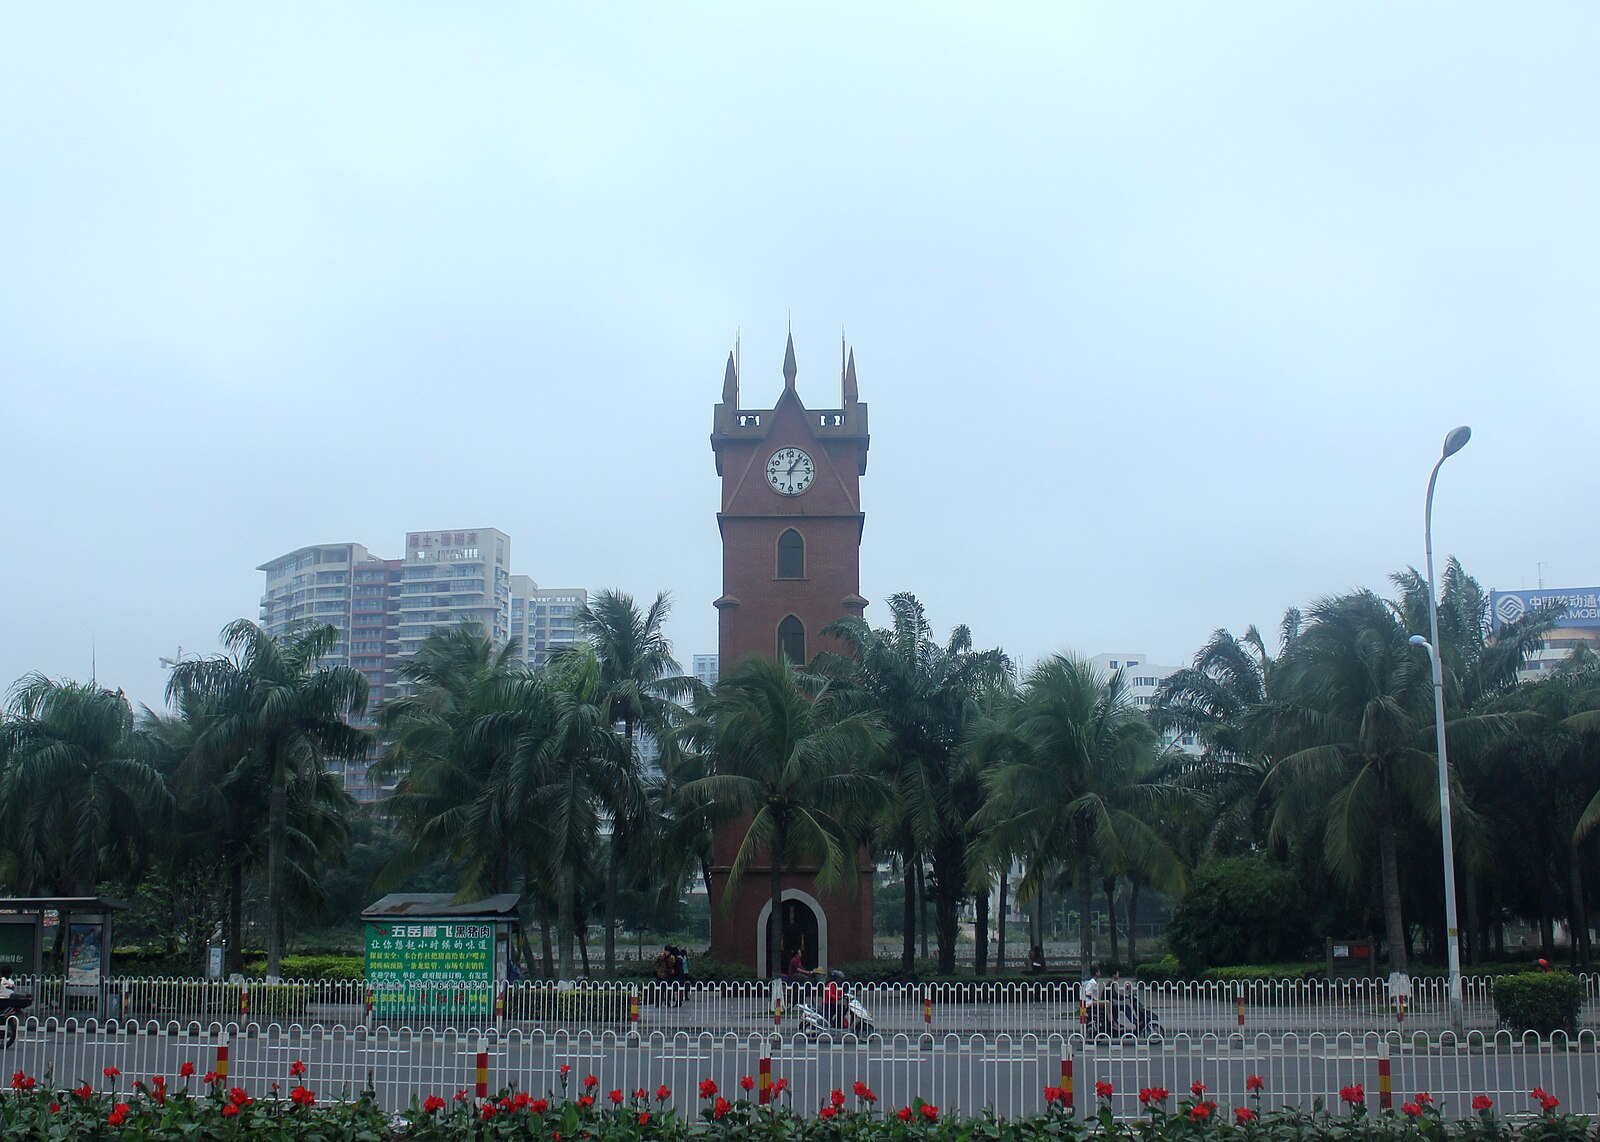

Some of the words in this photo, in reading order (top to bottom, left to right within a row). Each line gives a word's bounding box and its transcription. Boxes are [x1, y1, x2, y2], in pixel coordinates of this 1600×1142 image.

[392, 925, 490, 938] 五岳腾飞黑猪肉
[371, 940, 487, 950] 让你想起小时候的味道
